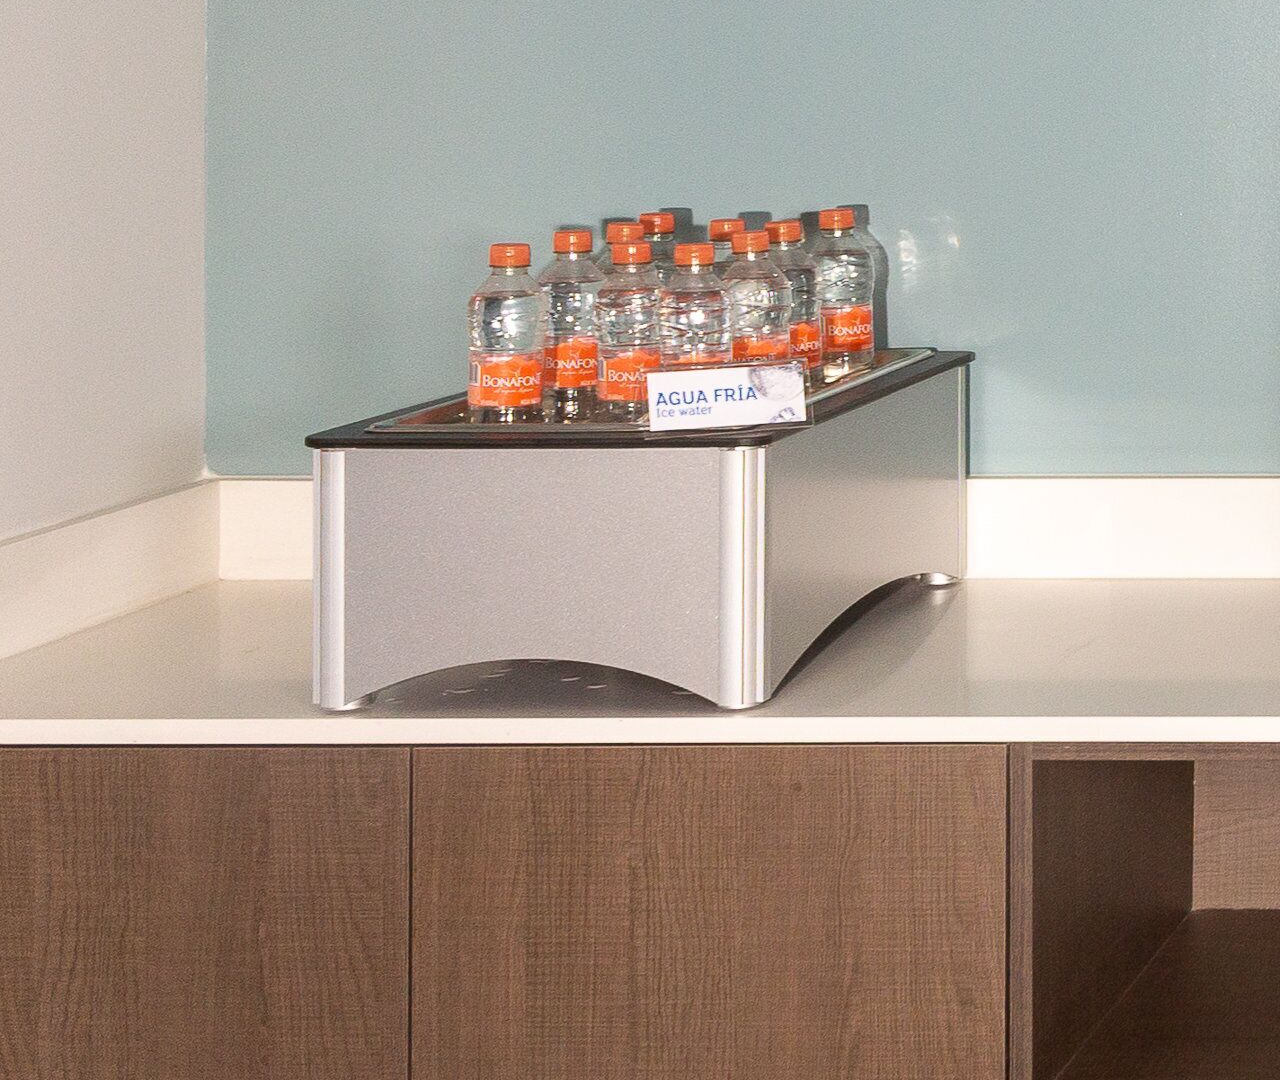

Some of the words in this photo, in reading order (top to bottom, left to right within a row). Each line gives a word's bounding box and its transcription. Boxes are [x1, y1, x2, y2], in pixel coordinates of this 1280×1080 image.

[656, 390, 709, 406] AGUA
[714, 385, 758, 402] FRÍA
[656, 408, 676, 418] Ice
[679, 406, 713, 417] water
